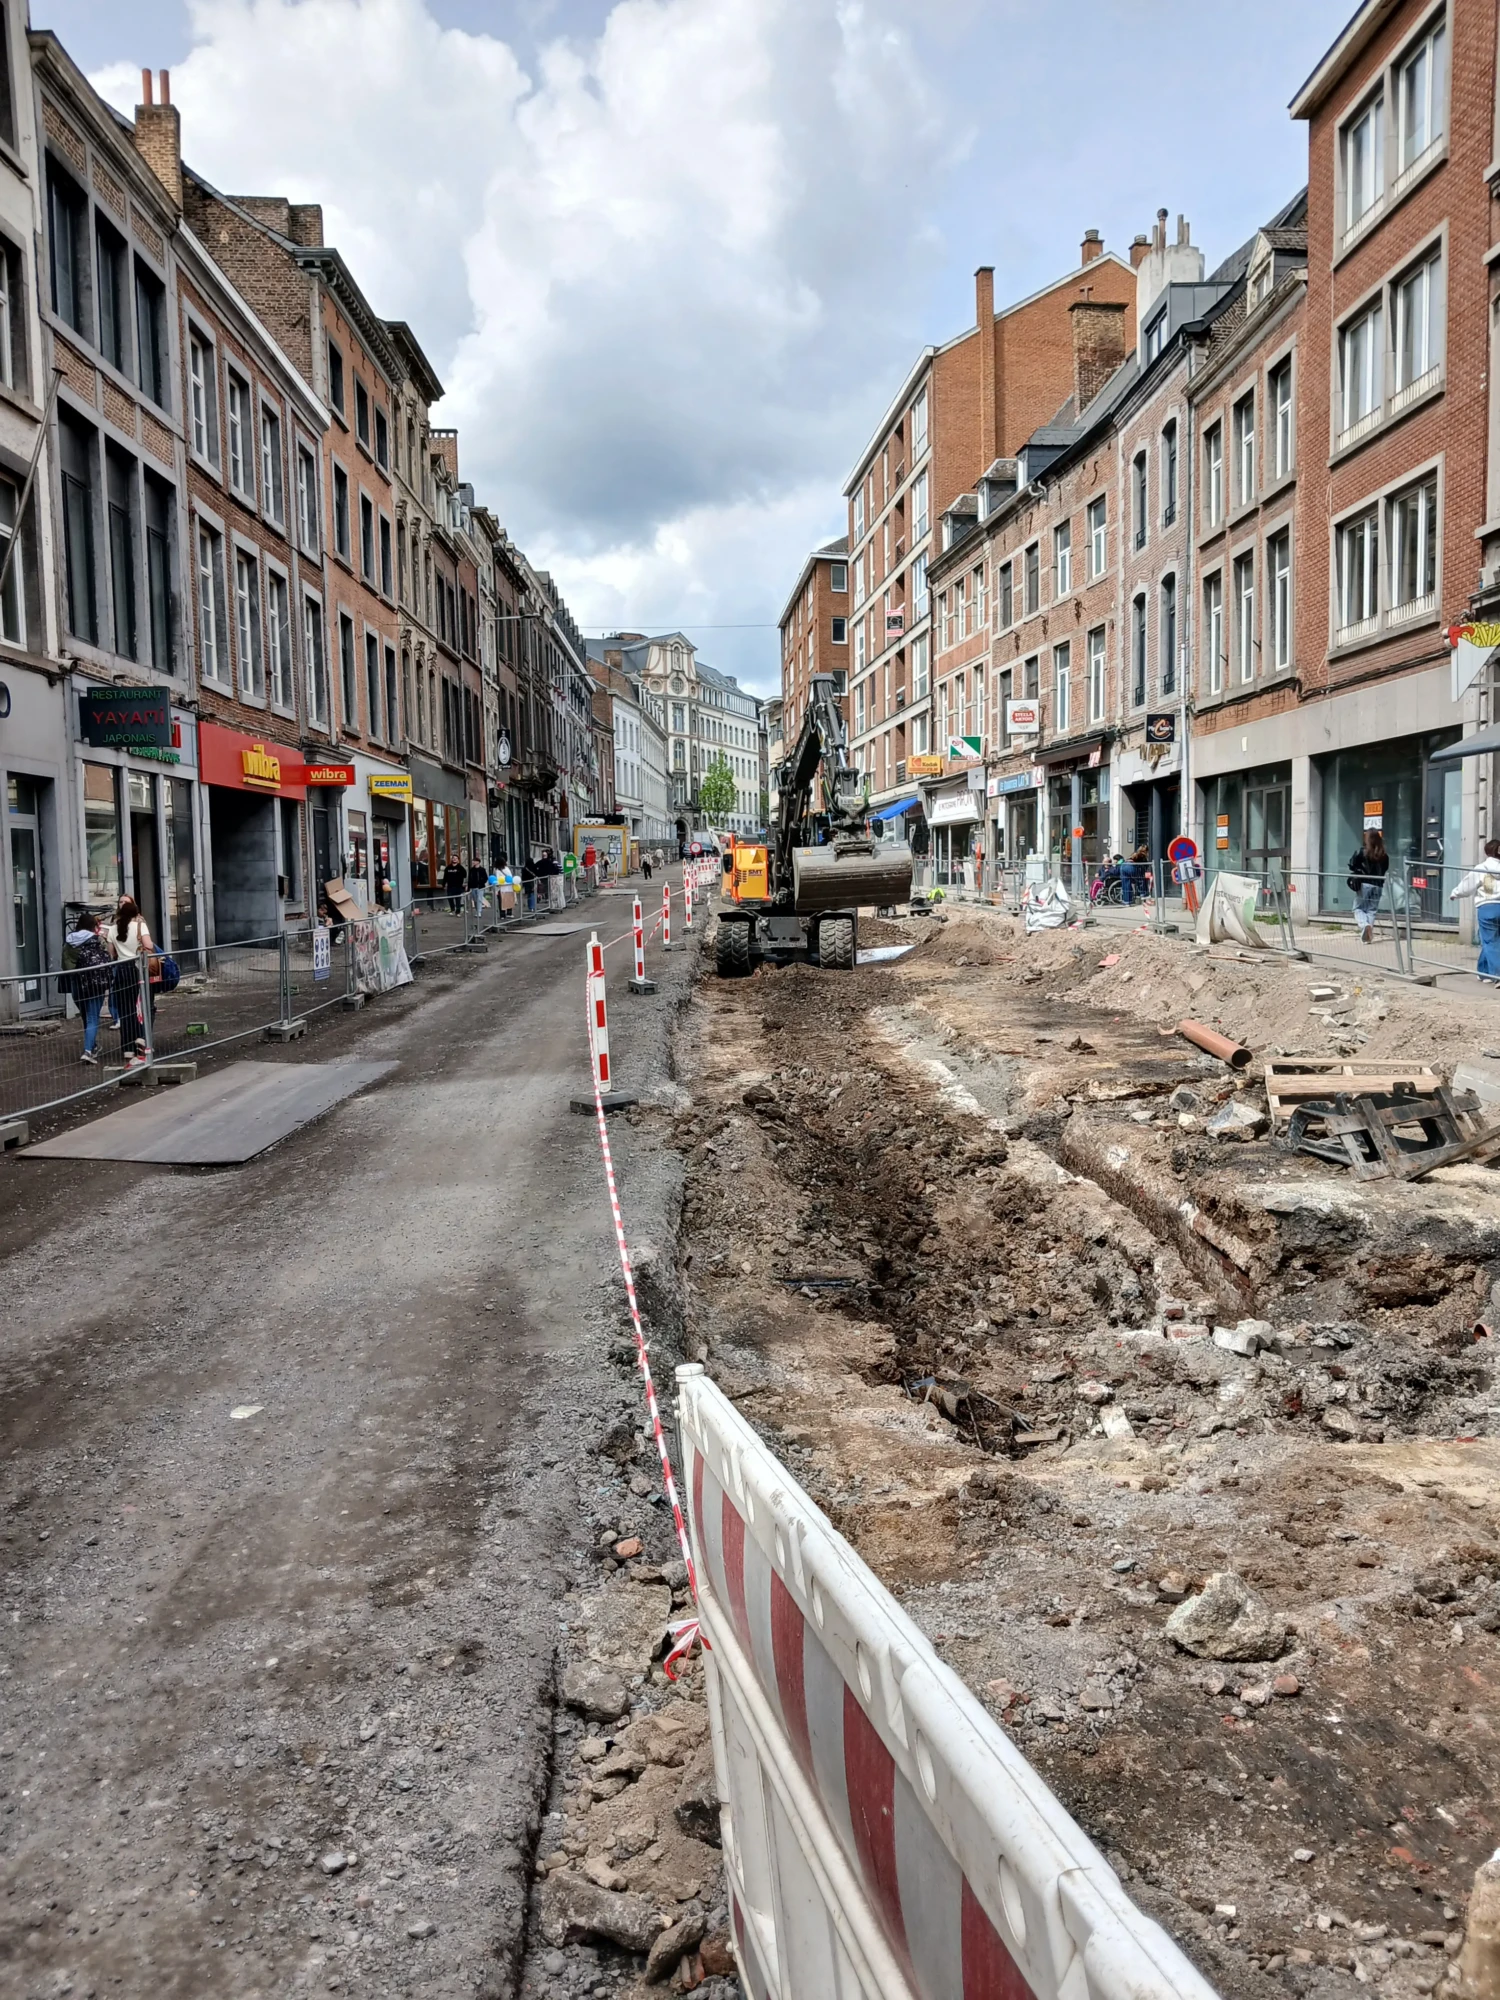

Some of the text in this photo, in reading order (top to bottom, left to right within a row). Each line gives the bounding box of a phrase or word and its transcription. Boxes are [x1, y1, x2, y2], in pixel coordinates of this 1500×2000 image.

[91, 690, 163, 700] RESTAURANT
[103, 734, 156, 743] JAPONAIS
[242, 744, 281, 781] wibra
[311, 768, 347, 779] wibra
